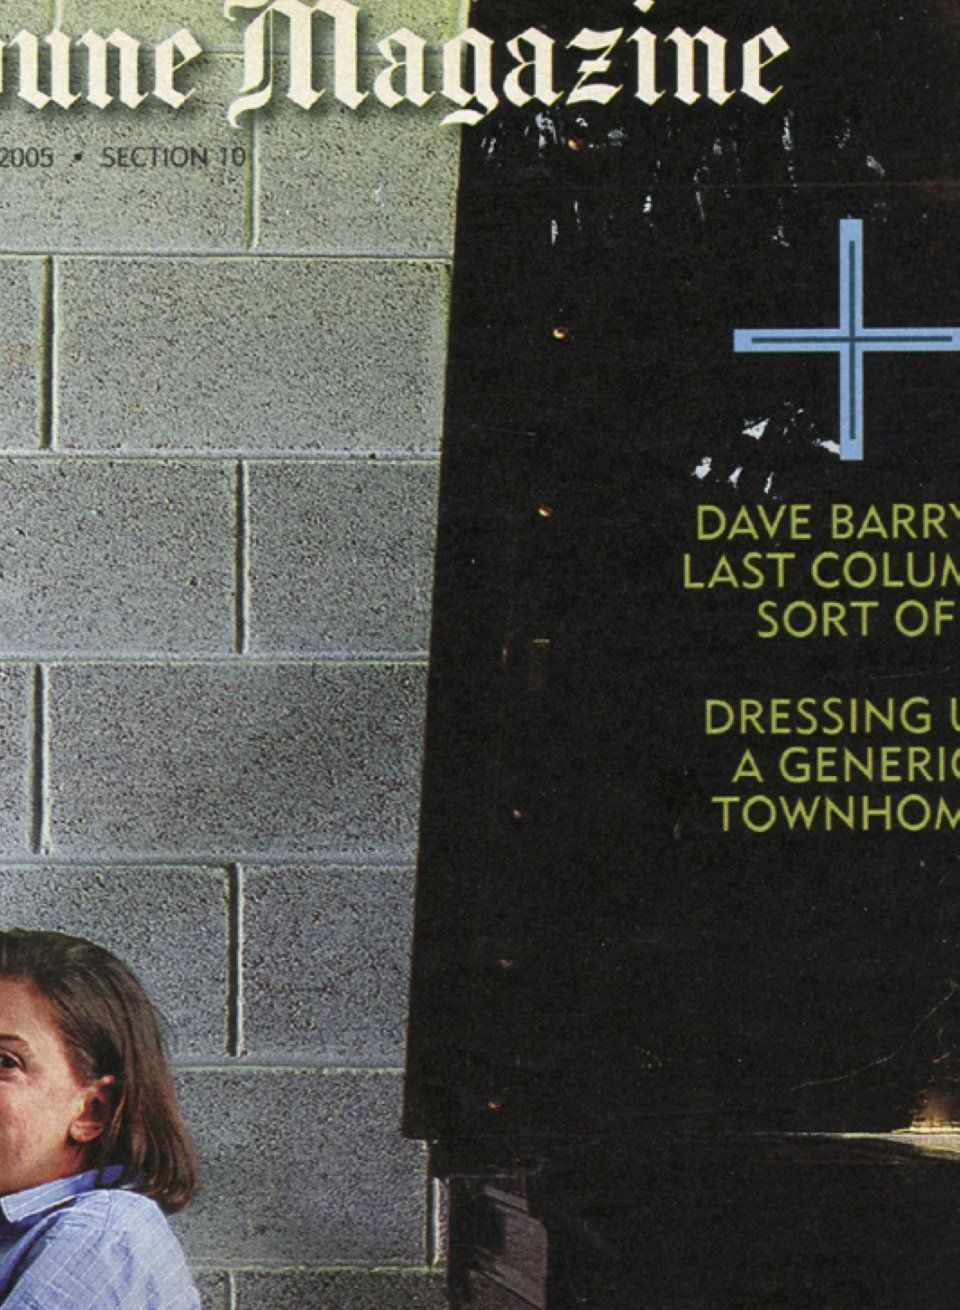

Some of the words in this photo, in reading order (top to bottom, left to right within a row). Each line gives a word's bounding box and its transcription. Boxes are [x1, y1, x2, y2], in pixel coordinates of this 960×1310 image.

[226, 0, 790, 127] Magazine
[100, 148, 208, 168] SECTION
[220, 148, 246, 168] 10
[697, 504, 811, 540] DAVE
[684, 552, 795, 589] LAST
[758, 600, 878, 637] SORT
[895, 600, 955, 637] OF
[706, 698, 932, 735] DRESSING
[732, 749, 763, 783] A
